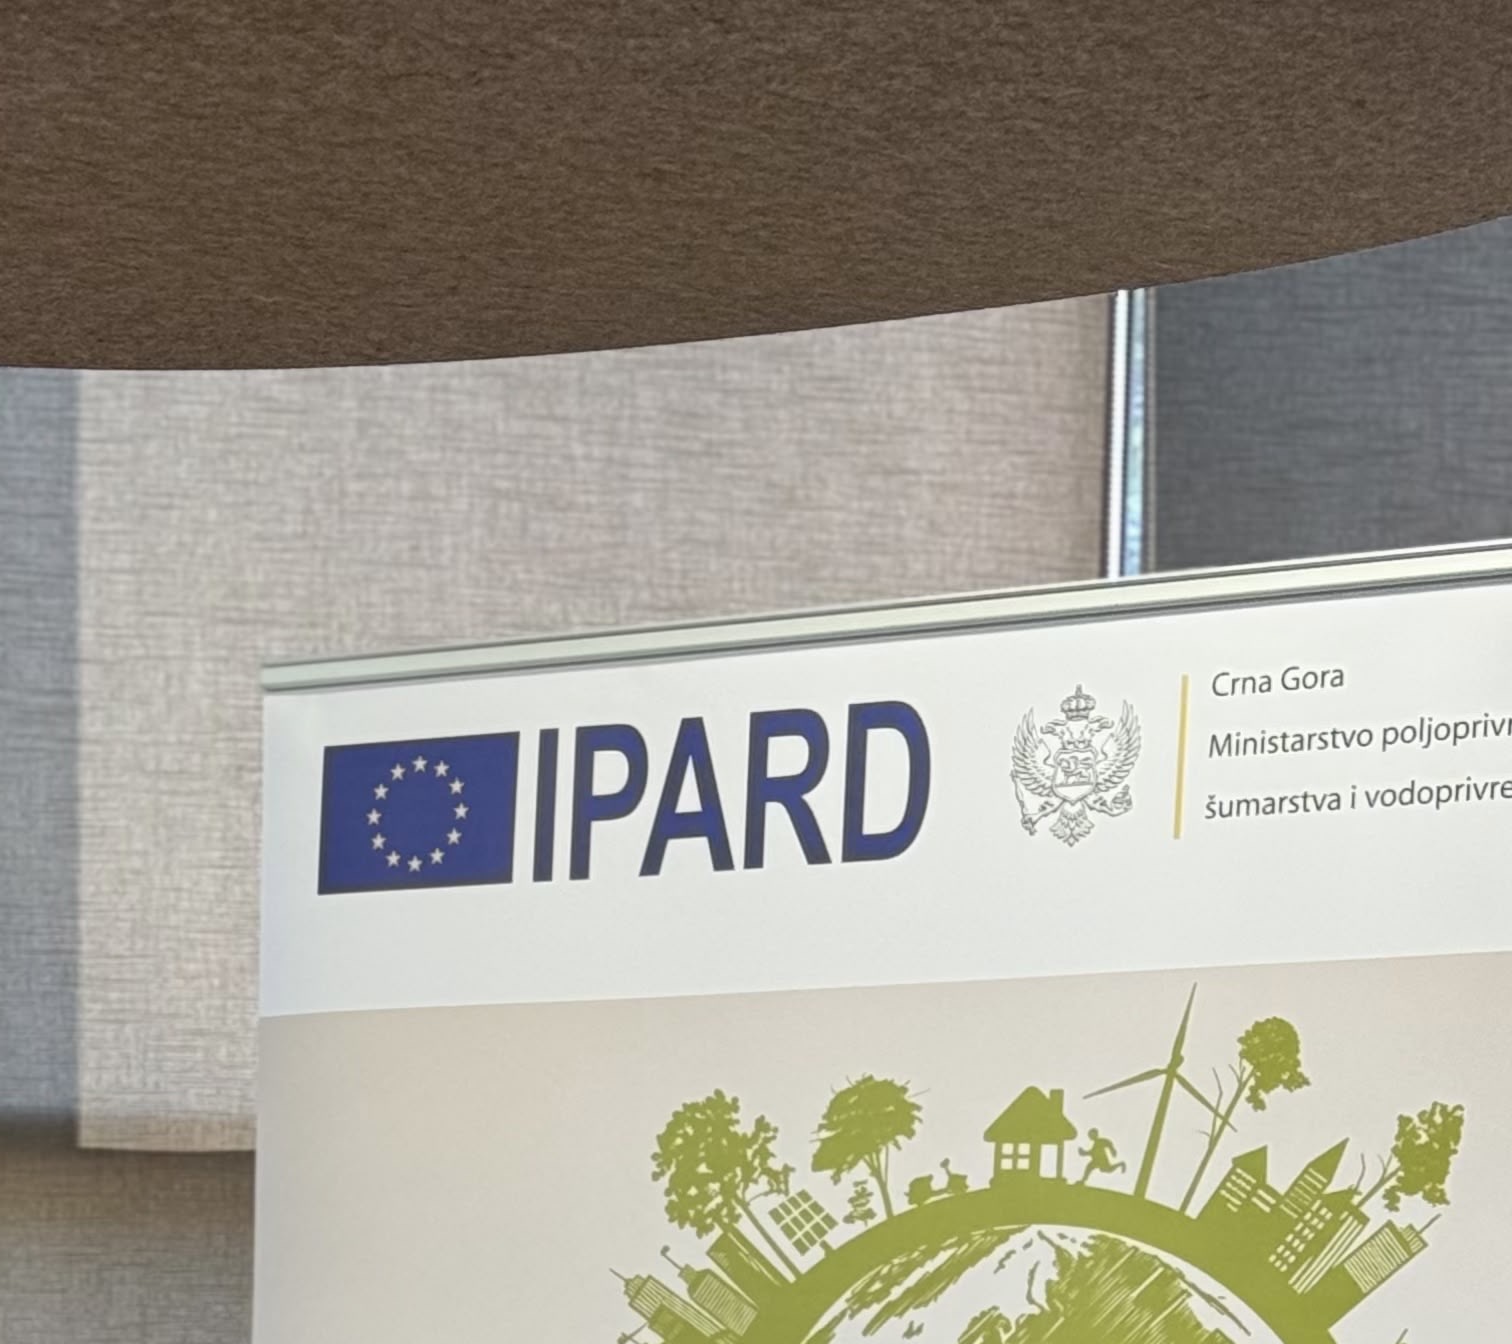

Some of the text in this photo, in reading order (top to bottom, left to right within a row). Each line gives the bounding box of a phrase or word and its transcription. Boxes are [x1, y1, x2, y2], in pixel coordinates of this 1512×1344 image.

[1211, 666, 1345, 697] Crna Gora
[1208, 727, 1373, 758] Ministarstvo
[532, 700, 931, 882] IPARD
[1204, 791, 1340, 819] šumarstva
[1350, 785, 1357, 809] i
